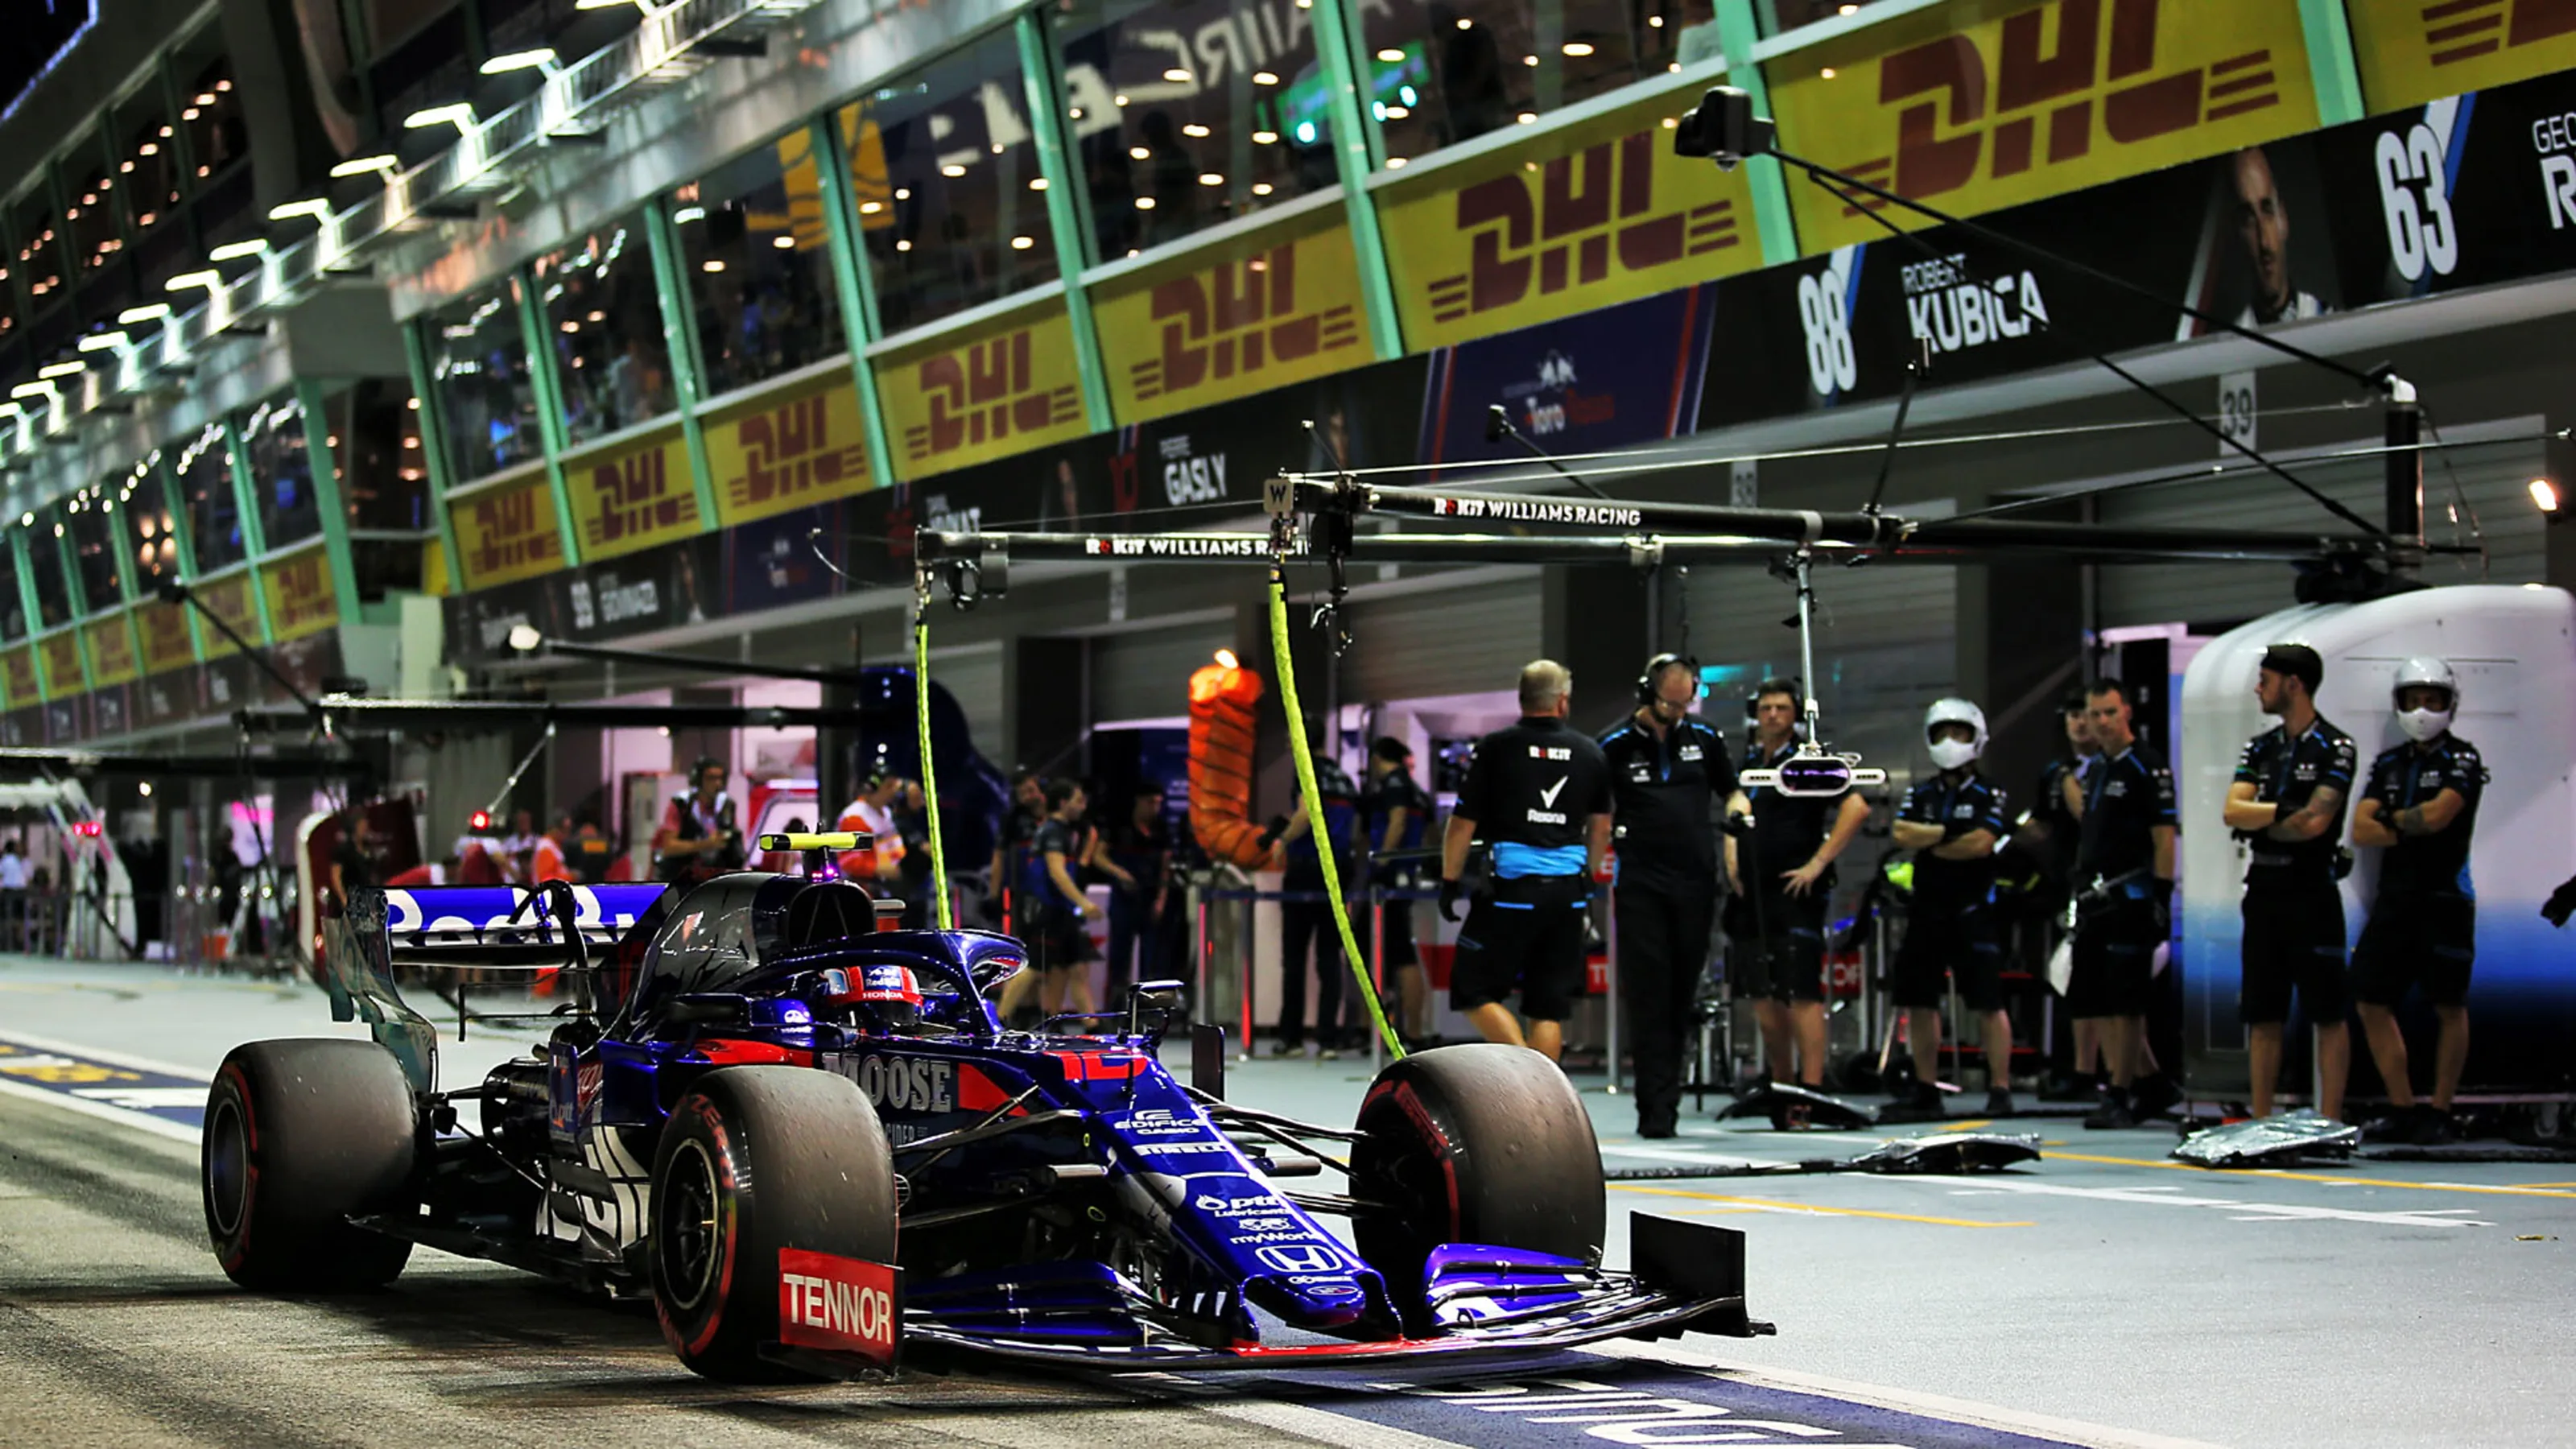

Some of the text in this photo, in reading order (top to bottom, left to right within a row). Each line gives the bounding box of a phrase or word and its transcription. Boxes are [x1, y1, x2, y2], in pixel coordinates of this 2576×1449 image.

[1880, 0, 2204, 200] DHL
[1458, 130, 1686, 313] DHL
[2376, 123, 2458, 281] 63
[1901, 253, 1967, 295] ROBERT
[1907, 270, 2050, 353] KUBICA
[1151, 244, 1321, 393] DHL
[1798, 269, 1857, 395] 88
[920, 331, 1051, 453] DHL
[2223, 387, 2252, 436] 39
[740, 396, 843, 502] DHL
[1164, 452, 1227, 506] GASLY
[475, 490, 546, 574] DHL
[594, 448, 679, 545] DHL
[1269, 485, 1286, 504] W
[1488, 500, 1573, 522] WILLIAMS
[1575, 506, 1641, 526] RACING
[1149, 539, 1251, 555] WILLIAMS
[862, 991, 904, 1000] HONDA
[783, 1273, 891, 1345] TENNOR
